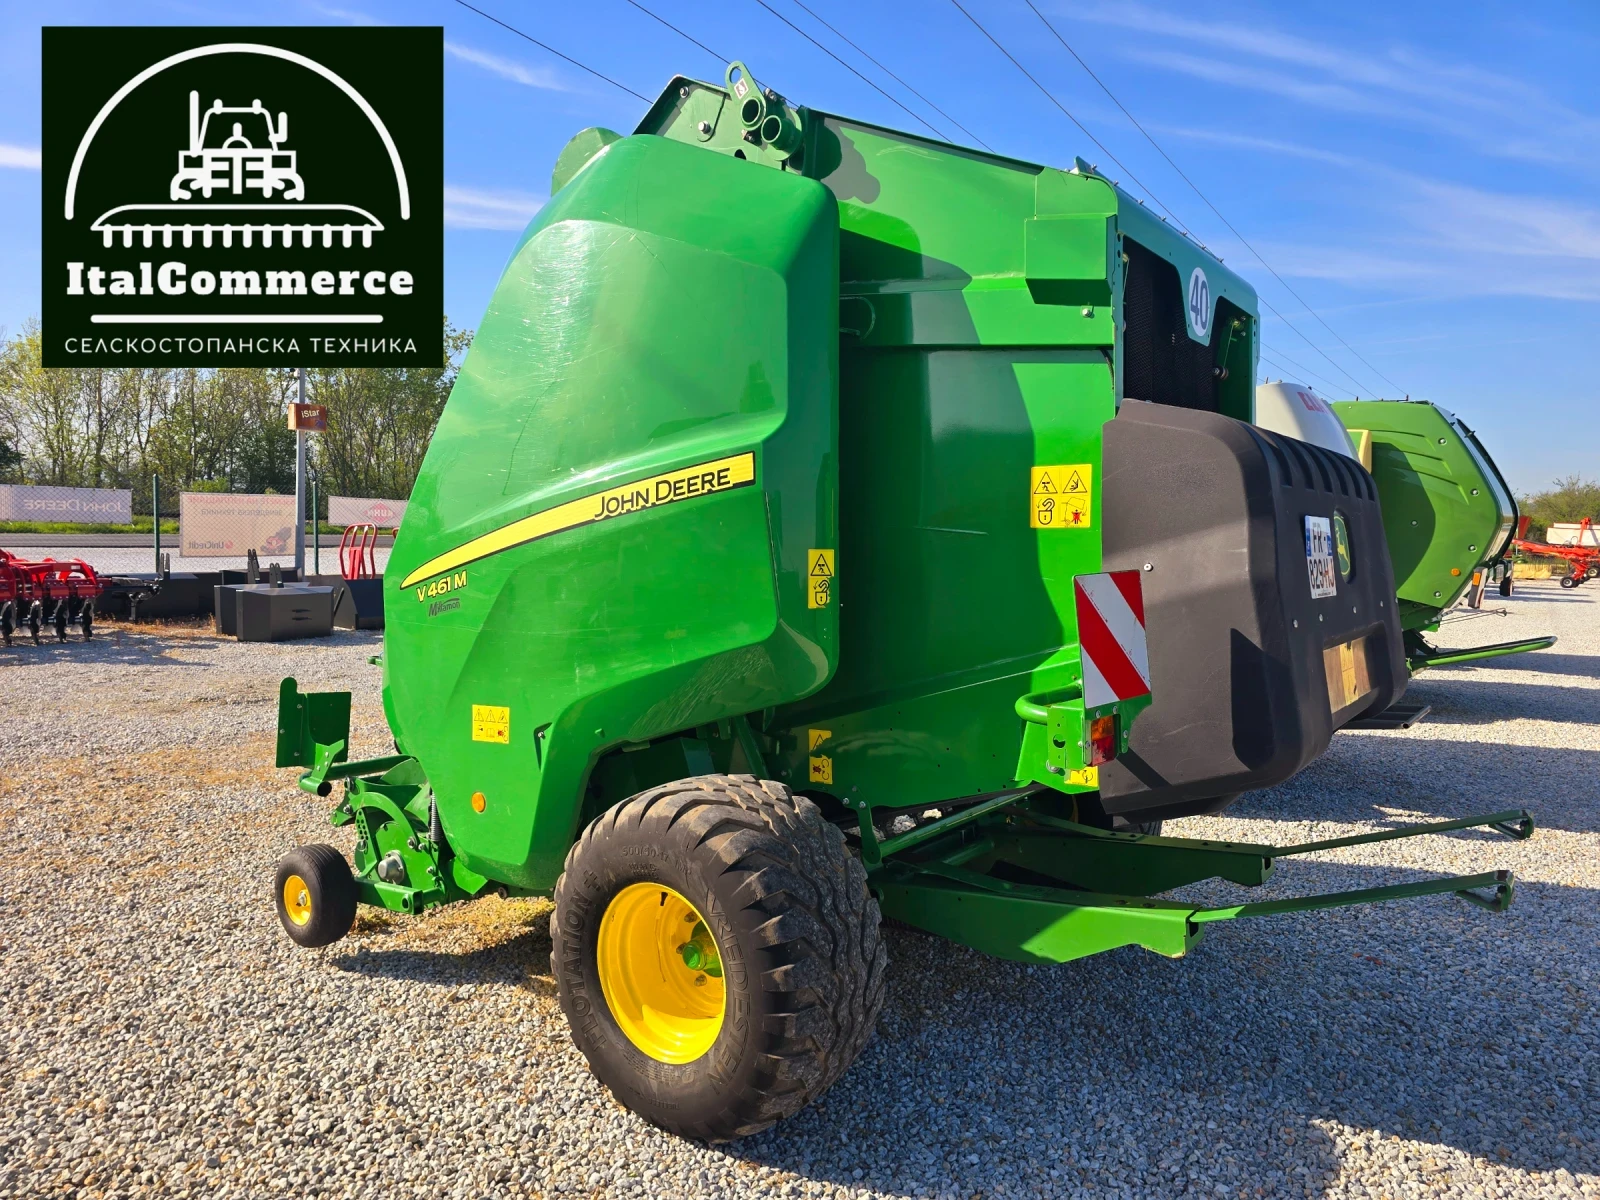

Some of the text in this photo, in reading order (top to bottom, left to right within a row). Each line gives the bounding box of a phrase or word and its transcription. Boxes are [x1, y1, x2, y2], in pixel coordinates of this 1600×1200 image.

[1190, 274, 1209, 330] 40
[301, 409, 320, 418] iStar
[594, 467, 731, 518] JOHN DEERE
[416, 569, 467, 603] V 461 M
[562, 888, 607, 1052] FLOTATION
[706, 887, 750, 1096] VREDESTEIN
